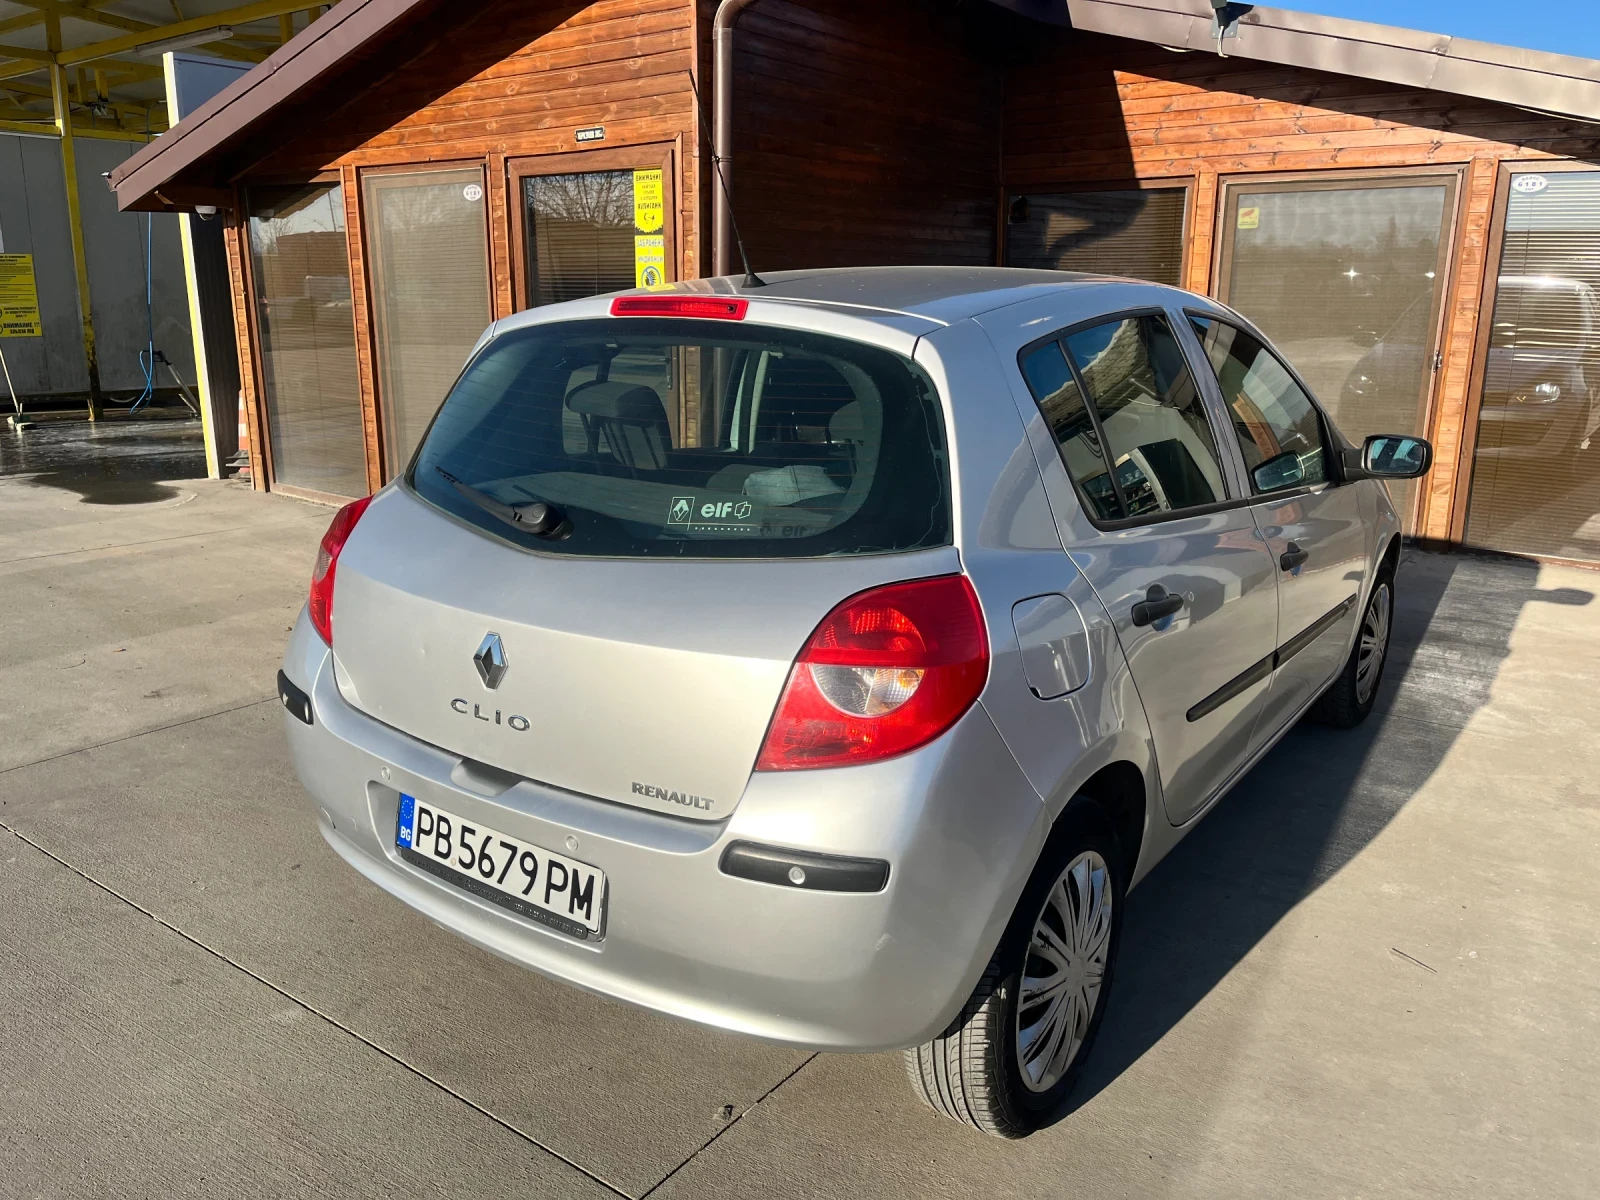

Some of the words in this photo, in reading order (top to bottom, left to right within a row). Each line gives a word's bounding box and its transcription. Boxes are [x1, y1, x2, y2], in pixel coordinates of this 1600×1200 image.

[701, 502, 732, 518] elf
[450, 697, 531, 732] CLIO
[631, 781, 715, 811] RENAULT
[400, 825, 411, 838] BG
